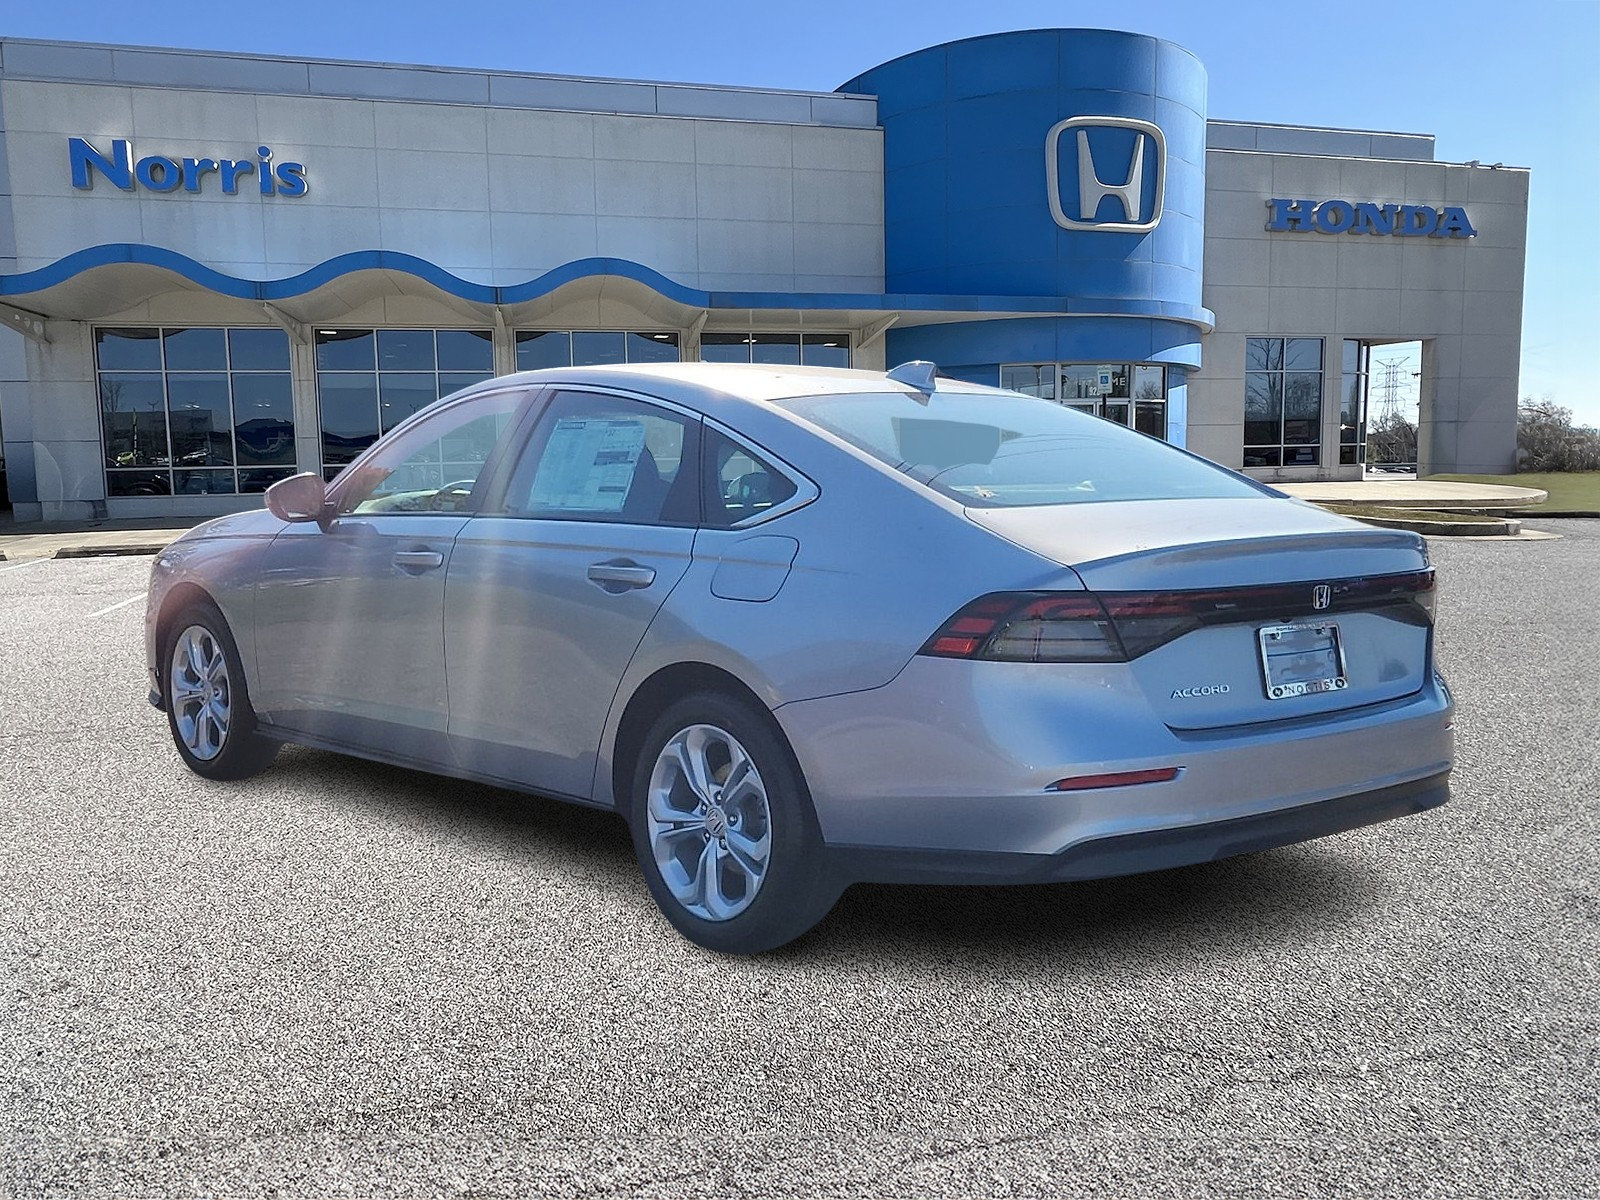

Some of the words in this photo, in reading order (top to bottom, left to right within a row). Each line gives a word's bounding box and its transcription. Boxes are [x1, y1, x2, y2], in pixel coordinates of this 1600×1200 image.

[68, 137, 309, 198] Norris
[1265, 198, 1478, 239] HONDA
[1170, 684, 1230, 699] ACCORD
